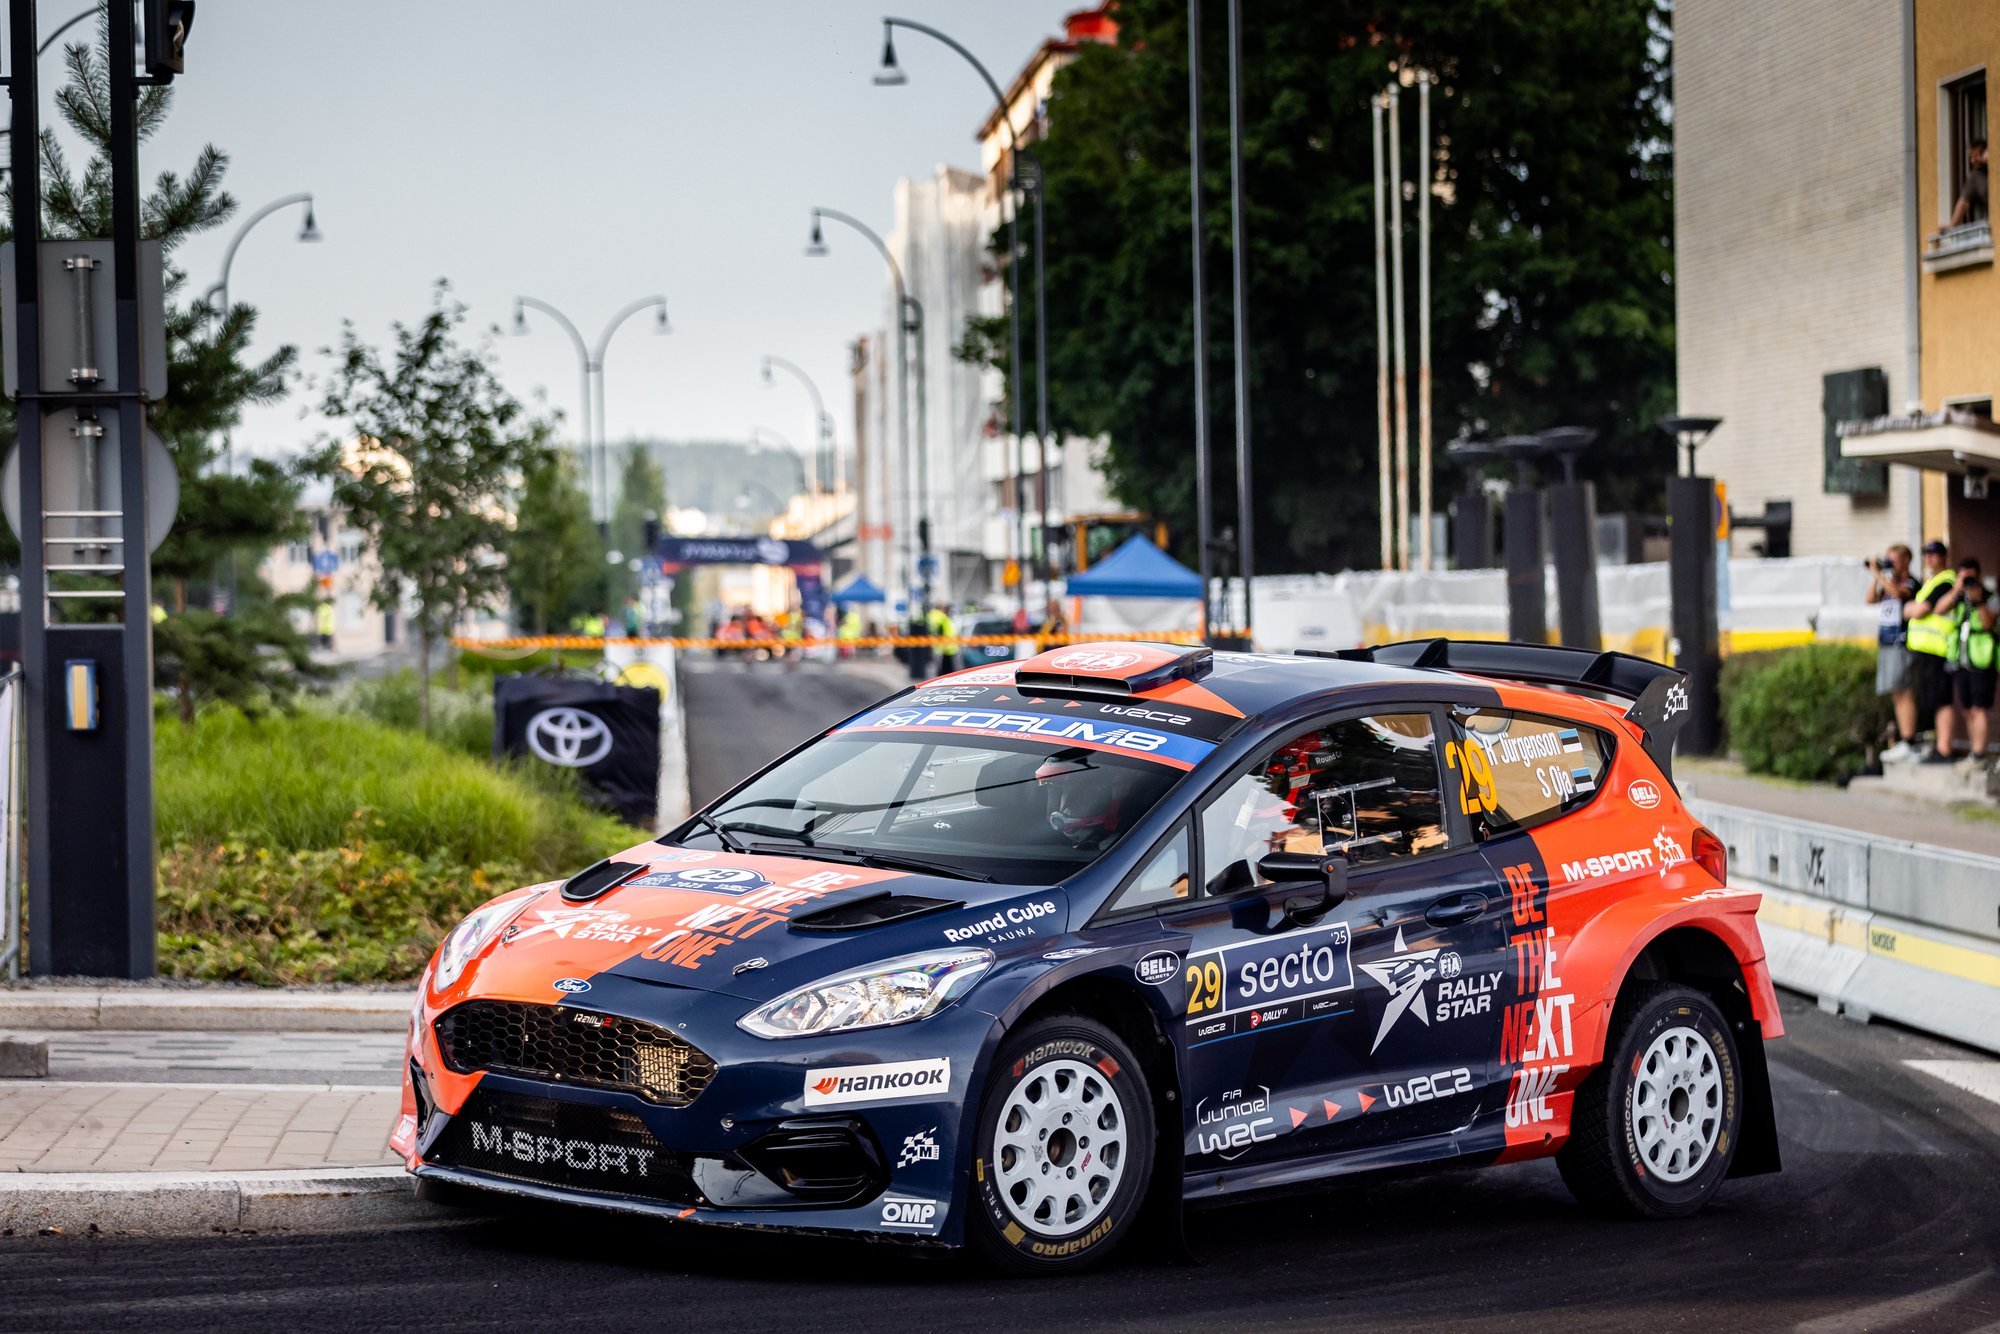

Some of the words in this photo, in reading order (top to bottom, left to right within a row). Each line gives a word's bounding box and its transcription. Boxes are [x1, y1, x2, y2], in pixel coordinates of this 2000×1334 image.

[1056, 652, 1134, 669] FIA
[916, 711, 1168, 751] FORUM8
[1498, 730, 1562, 768] Jürgenson
[1445, 738, 1498, 815] 29
[1535, 767, 1551, 798] S
[1549, 765, 1574, 802] Oja
[1631, 786, 1658, 801] BELL
[690, 869, 741, 881] 29
[1561, 848, 1653, 882] M-SPORT
[787, 870, 862, 892] BE
[736, 886, 826, 912] THE
[583, 923, 662, 936] RALLY
[674, 904, 790, 939] NEXT
[943, 912, 1007, 942] Round
[1007, 901, 1057, 923] Cube
[988, 927, 1035, 943] SAUNA
[573, 931, 637, 943] STAR
[640, 929, 735, 970] ONE
[1140, 956, 1175, 977] BELL
[1239, 943, 1334, 998] secto
[1440, 957, 1460, 975] FIA
[1510, 927, 1562, 996] THE
[557, 978, 587, 991] Ford
[1186, 961, 1221, 1014] 29
[1438, 971, 1503, 1001] RALLY
[1436, 994, 1491, 1022] STAR
[1198, 1022, 1226, 1037] WRC2
[1500, 994, 1575, 1066] NEXT
[1222, 1088, 1242, 1102] FIA
[1384, 1067, 1473, 1108] WRC2
[1505, 1064, 1570, 1128] ONE
[1201, 1100, 1267, 1125] JUNIOR
[471, 1121, 655, 1177] M-SPORT
[1199, 1117, 1277, 1155] WRC
[882, 1202, 936, 1223] OMP
